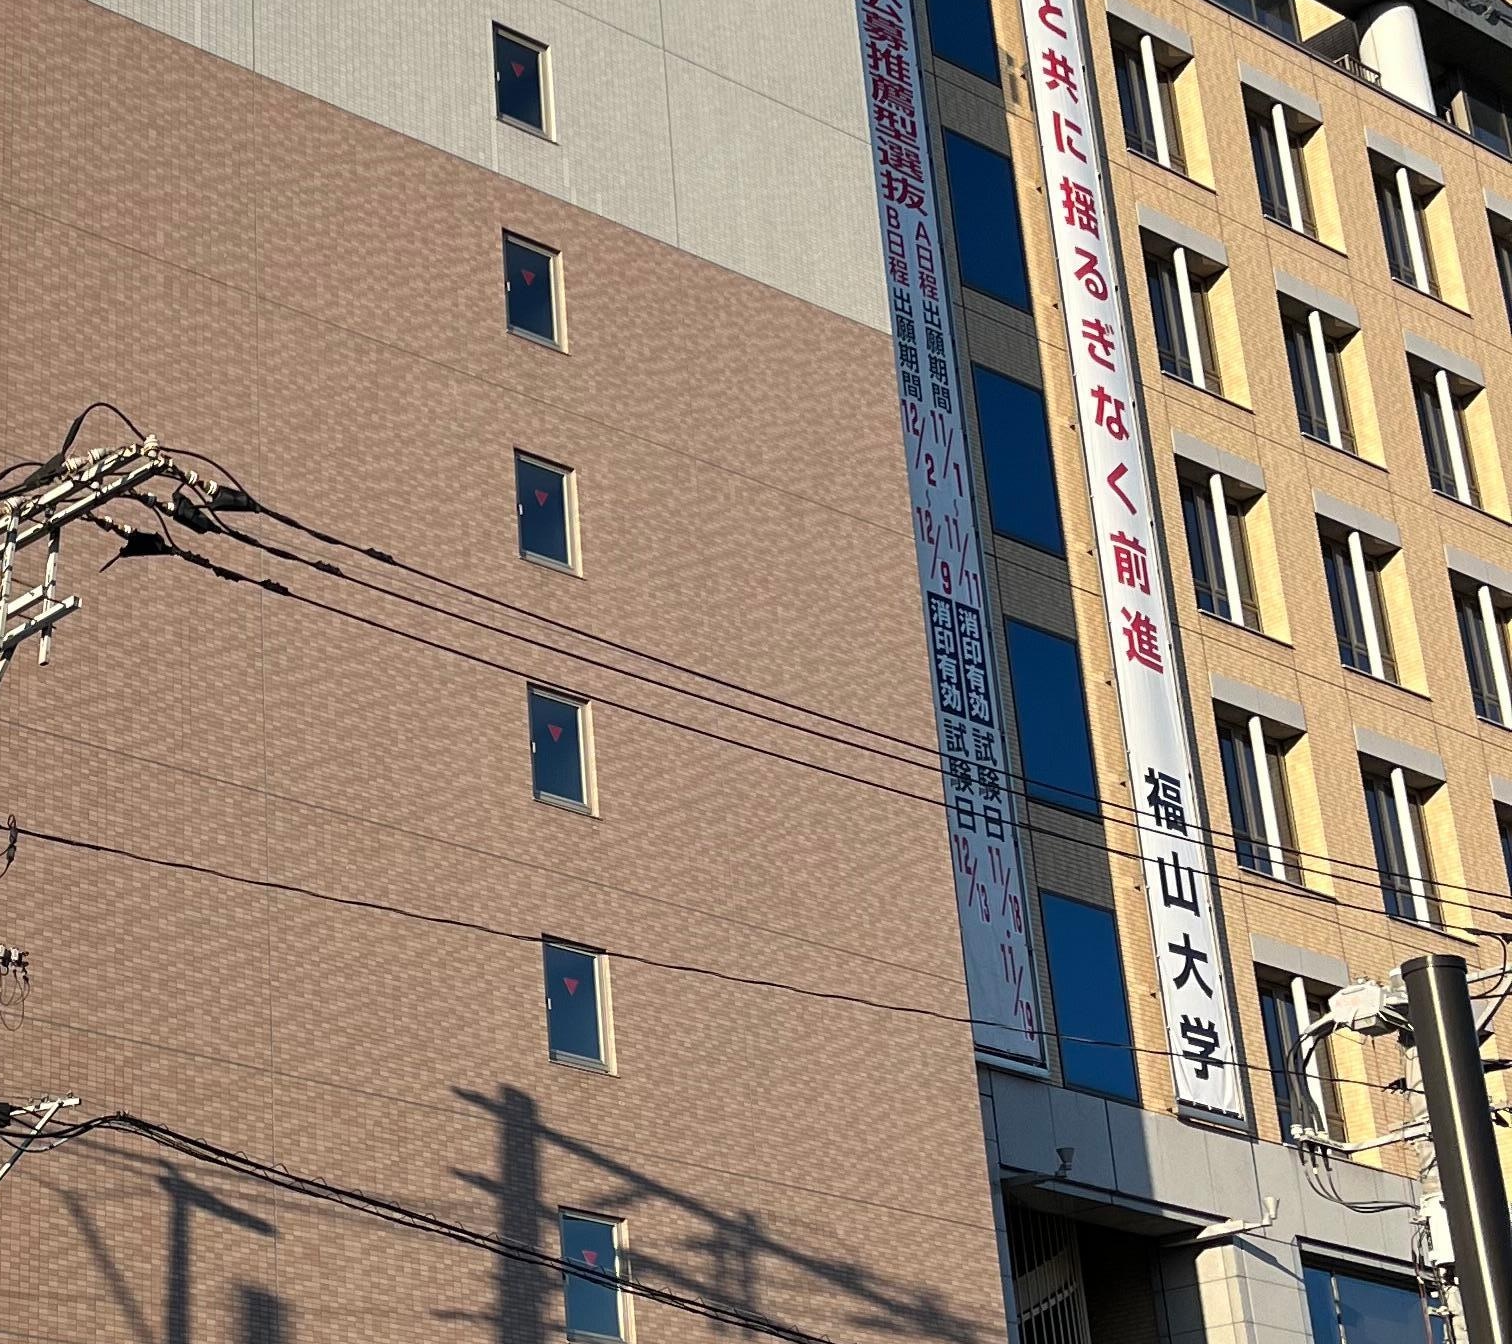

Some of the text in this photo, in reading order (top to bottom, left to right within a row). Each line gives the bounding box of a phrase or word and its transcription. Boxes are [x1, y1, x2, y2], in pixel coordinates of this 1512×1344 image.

[931, 598, 962, 712] 消印有効
[958, 608, 990, 722] 消印有効
[944, 718, 976, 833] 試験日
[973, 728, 1004, 843] 試験日
[954, 834, 991, 923] 12/13
[1144, 767, 1225, 1080] 福山大学
